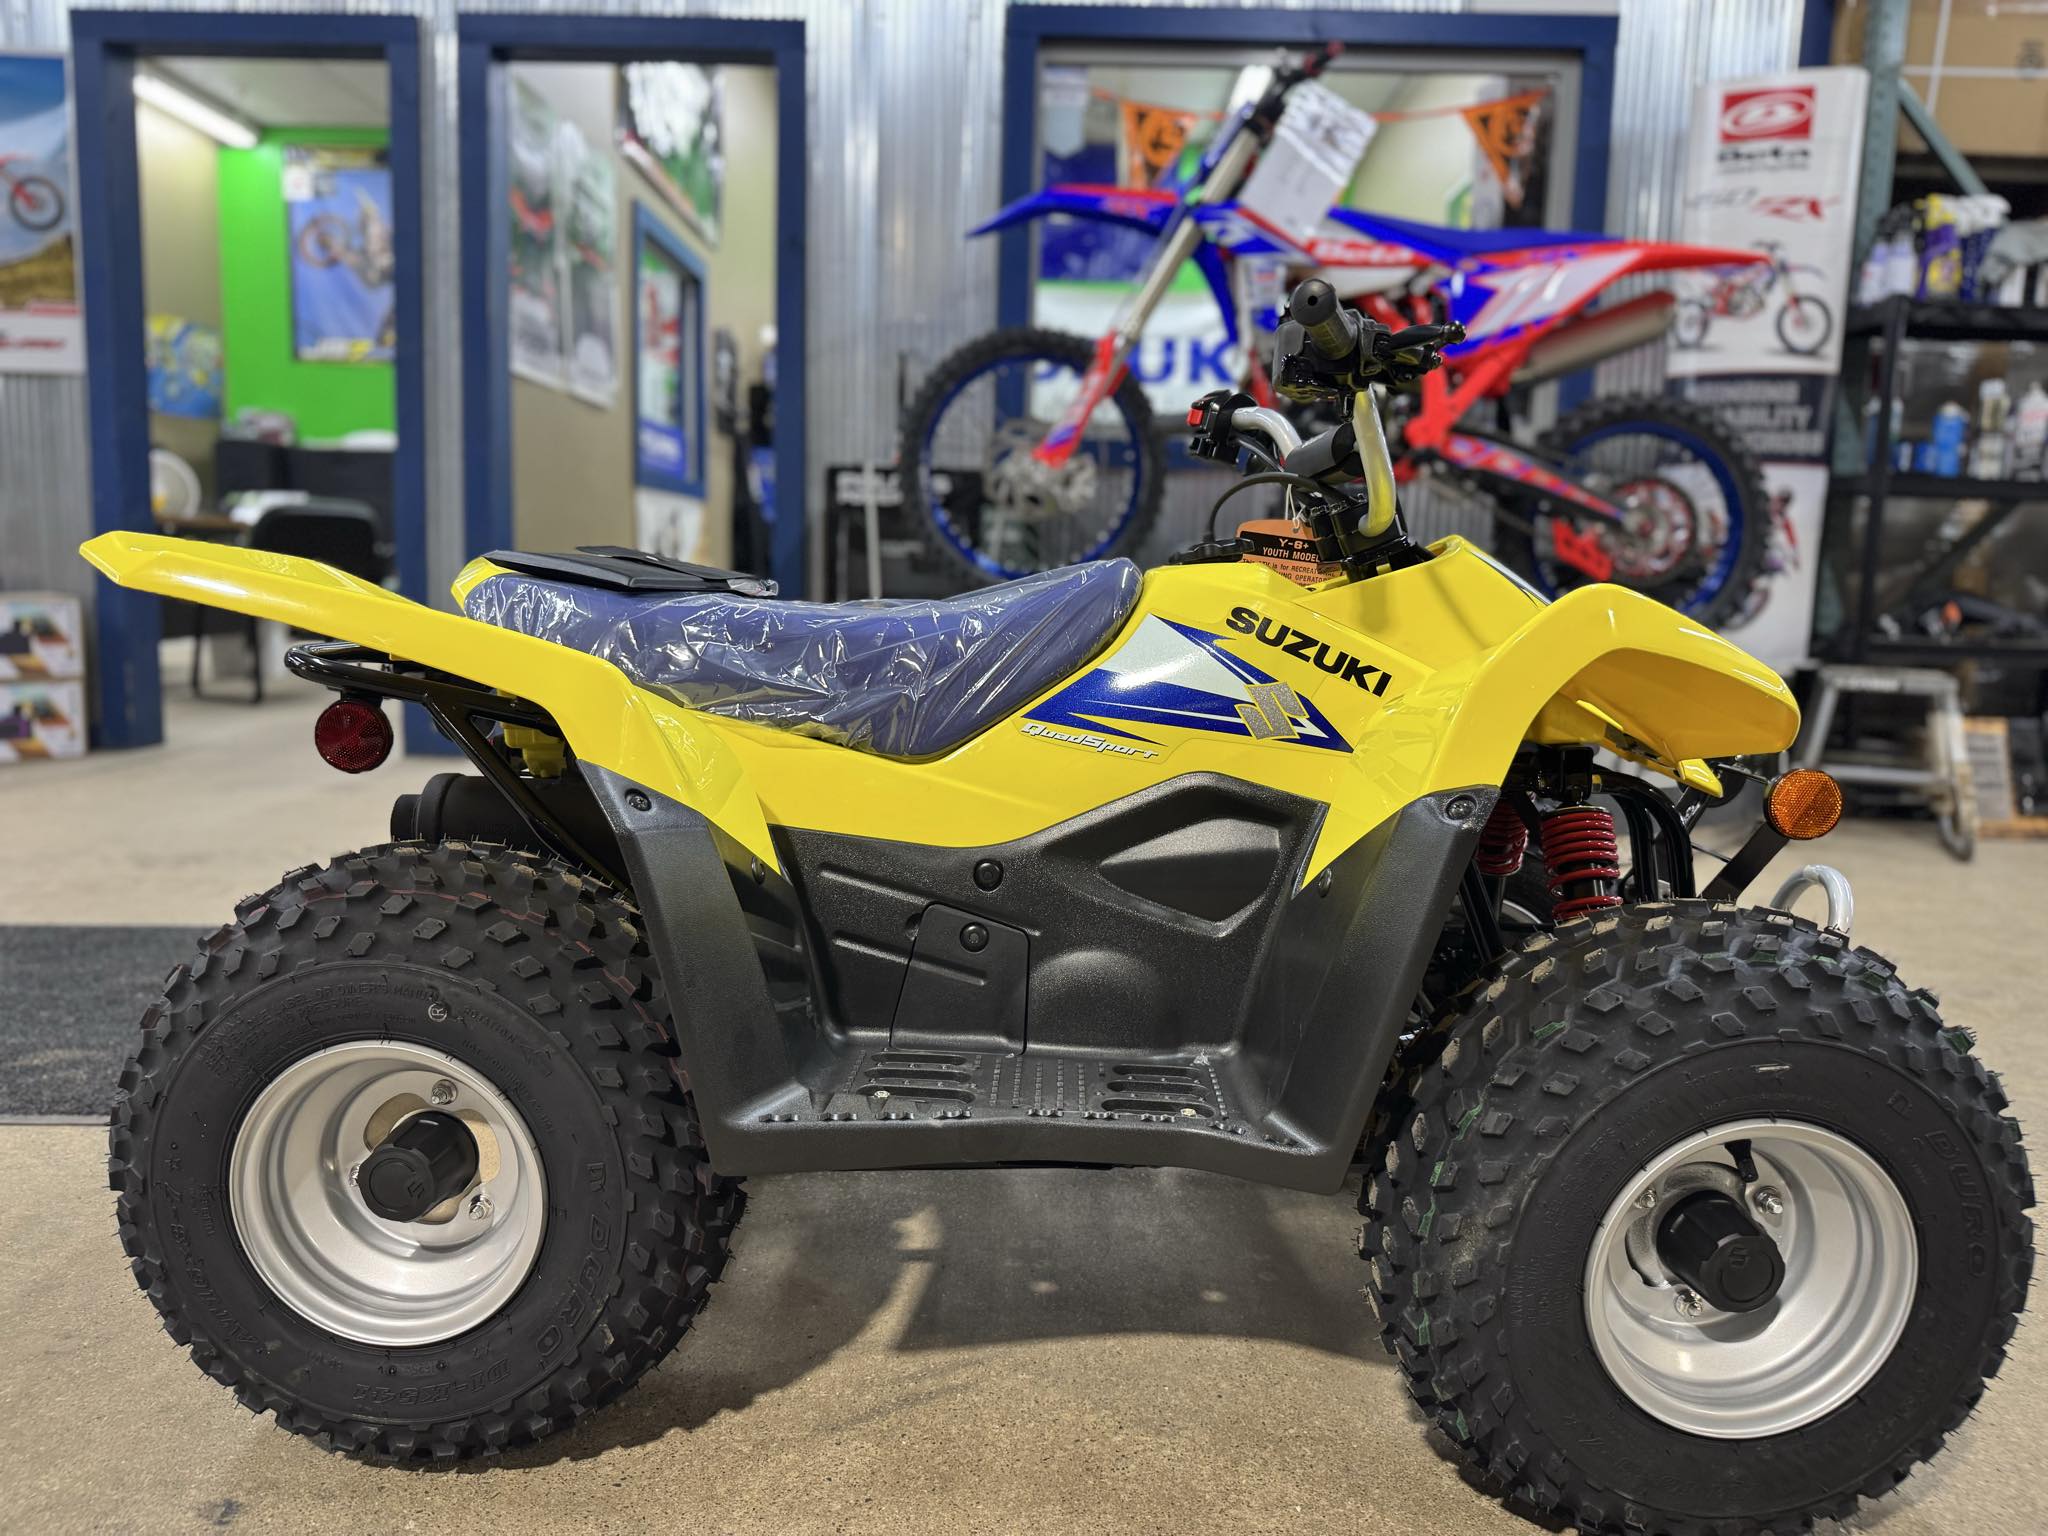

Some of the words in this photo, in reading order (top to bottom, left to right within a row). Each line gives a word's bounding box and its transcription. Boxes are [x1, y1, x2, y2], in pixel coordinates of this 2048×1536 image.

[1262, 546, 1290, 559] YOUTH
[1292, 551, 1320, 563] MODEL
[1280, 562, 1290, 571] for
[1225, 606, 1392, 698] SUZUKI
[1021, 722, 1159, 759] QuadSport
[1924, 1129, 1987, 1278] DURO
